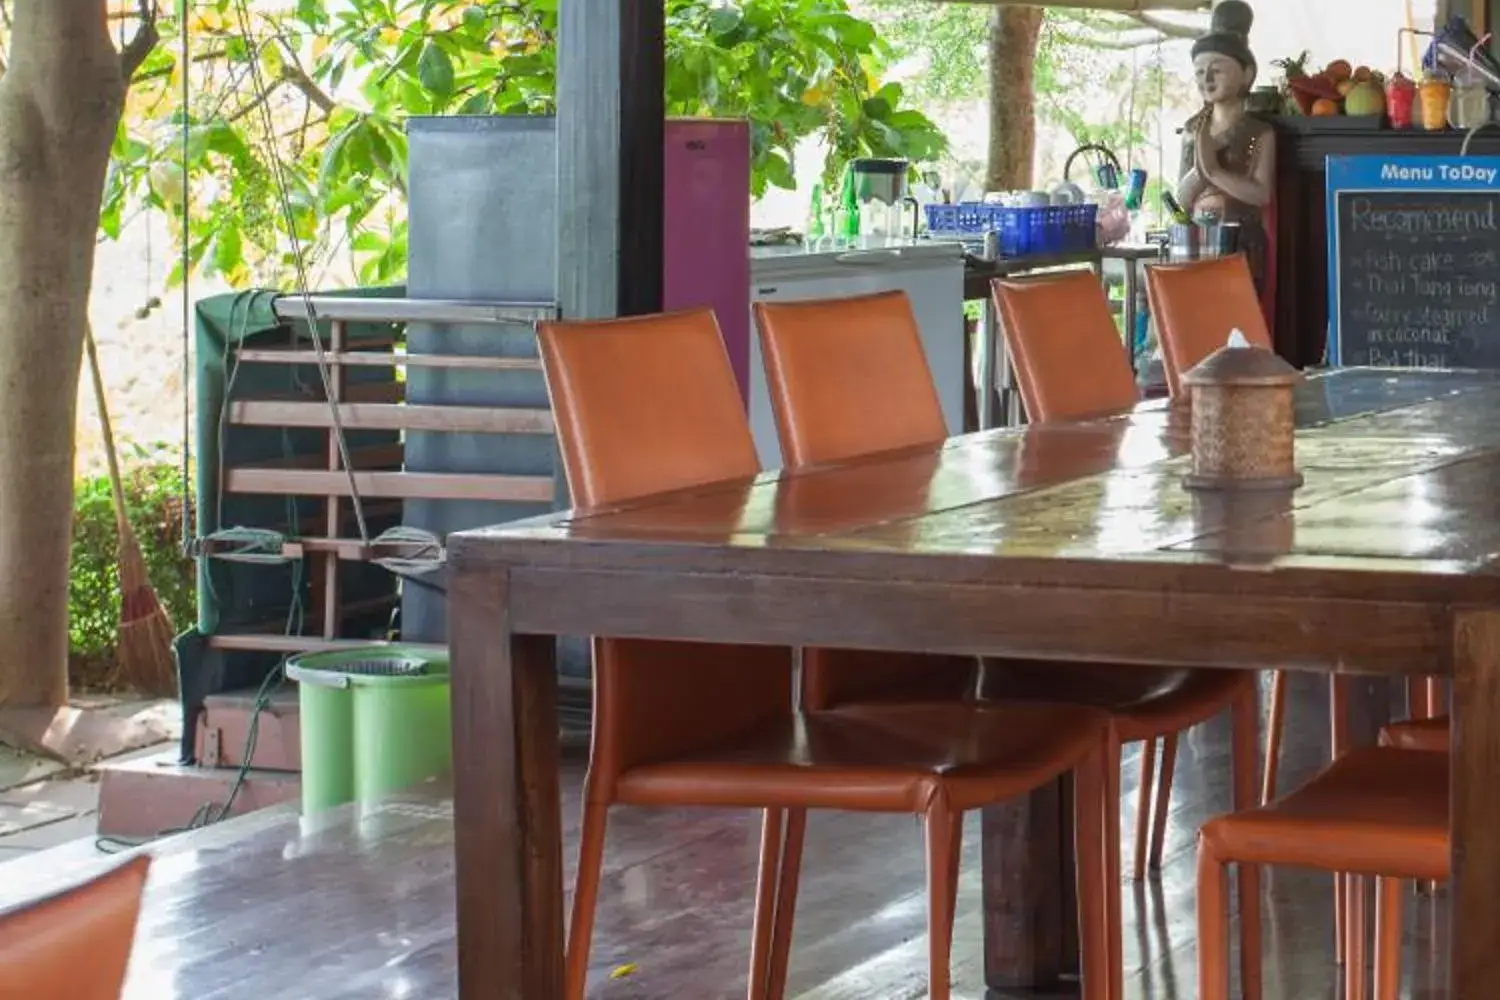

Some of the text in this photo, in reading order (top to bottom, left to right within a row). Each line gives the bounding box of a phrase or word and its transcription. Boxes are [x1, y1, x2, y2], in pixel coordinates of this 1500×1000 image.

[1380, 164, 1498, 184] Menu ToDay
[1351, 198, 1498, 234] Recommend
